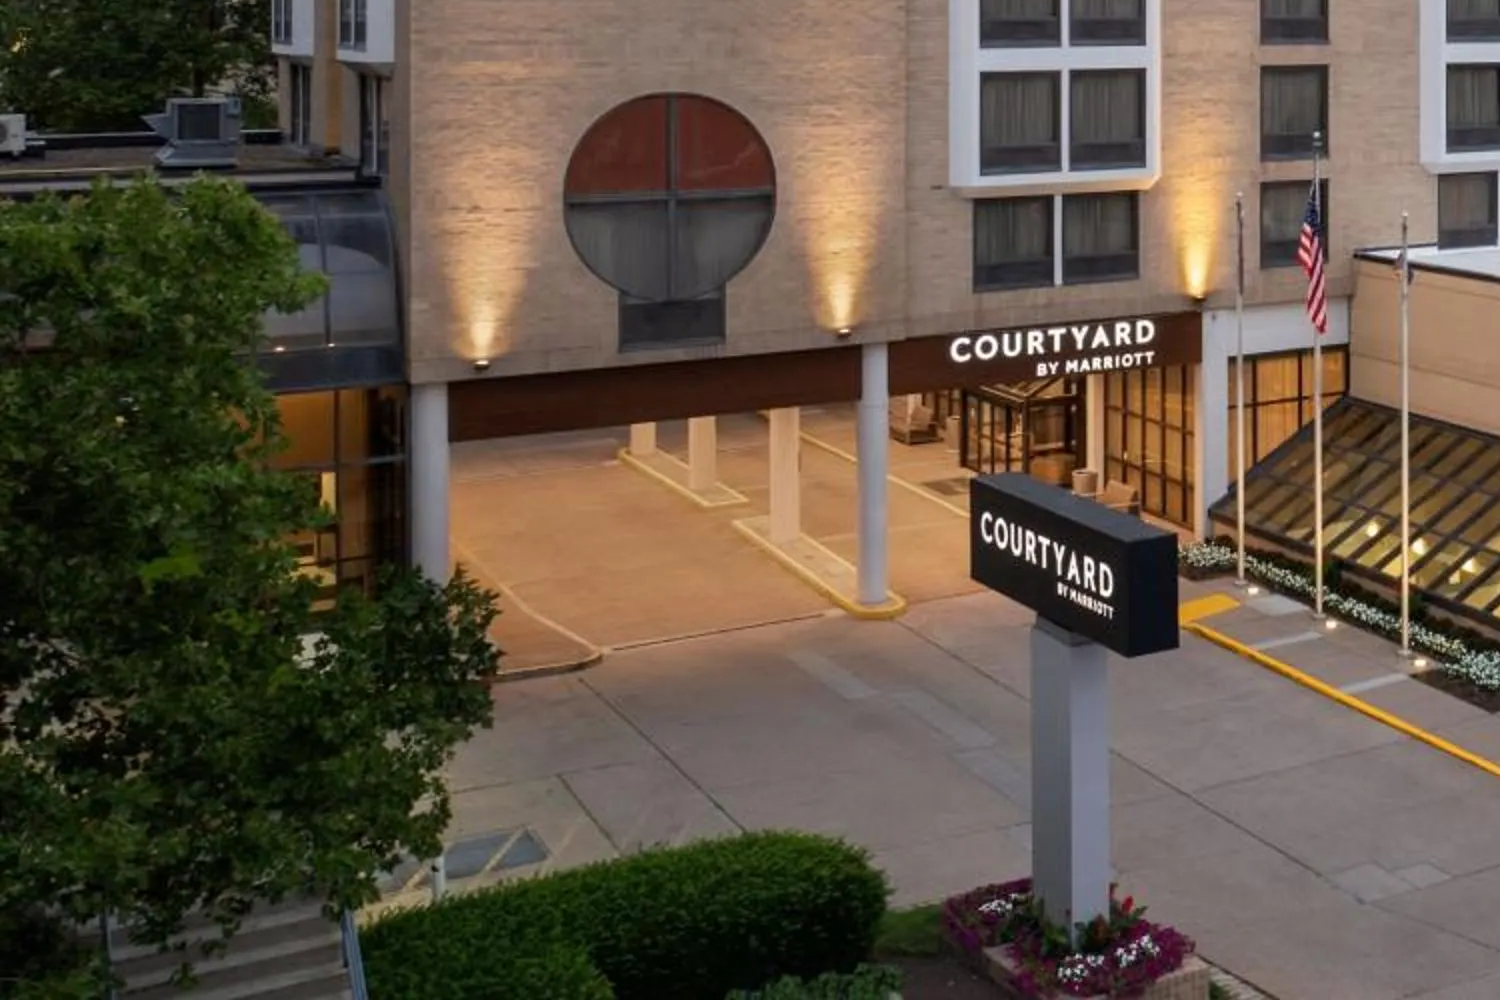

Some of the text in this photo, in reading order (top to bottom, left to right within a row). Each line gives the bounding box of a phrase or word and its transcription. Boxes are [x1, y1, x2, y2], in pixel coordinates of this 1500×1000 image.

[950, 319, 1156, 363] COURTYARD
[1036, 351, 1155, 377] BY MARRIOTT
[980, 511, 1114, 598] COURTYARD
[1056, 582, 1114, 619] BY MARRIOTT
